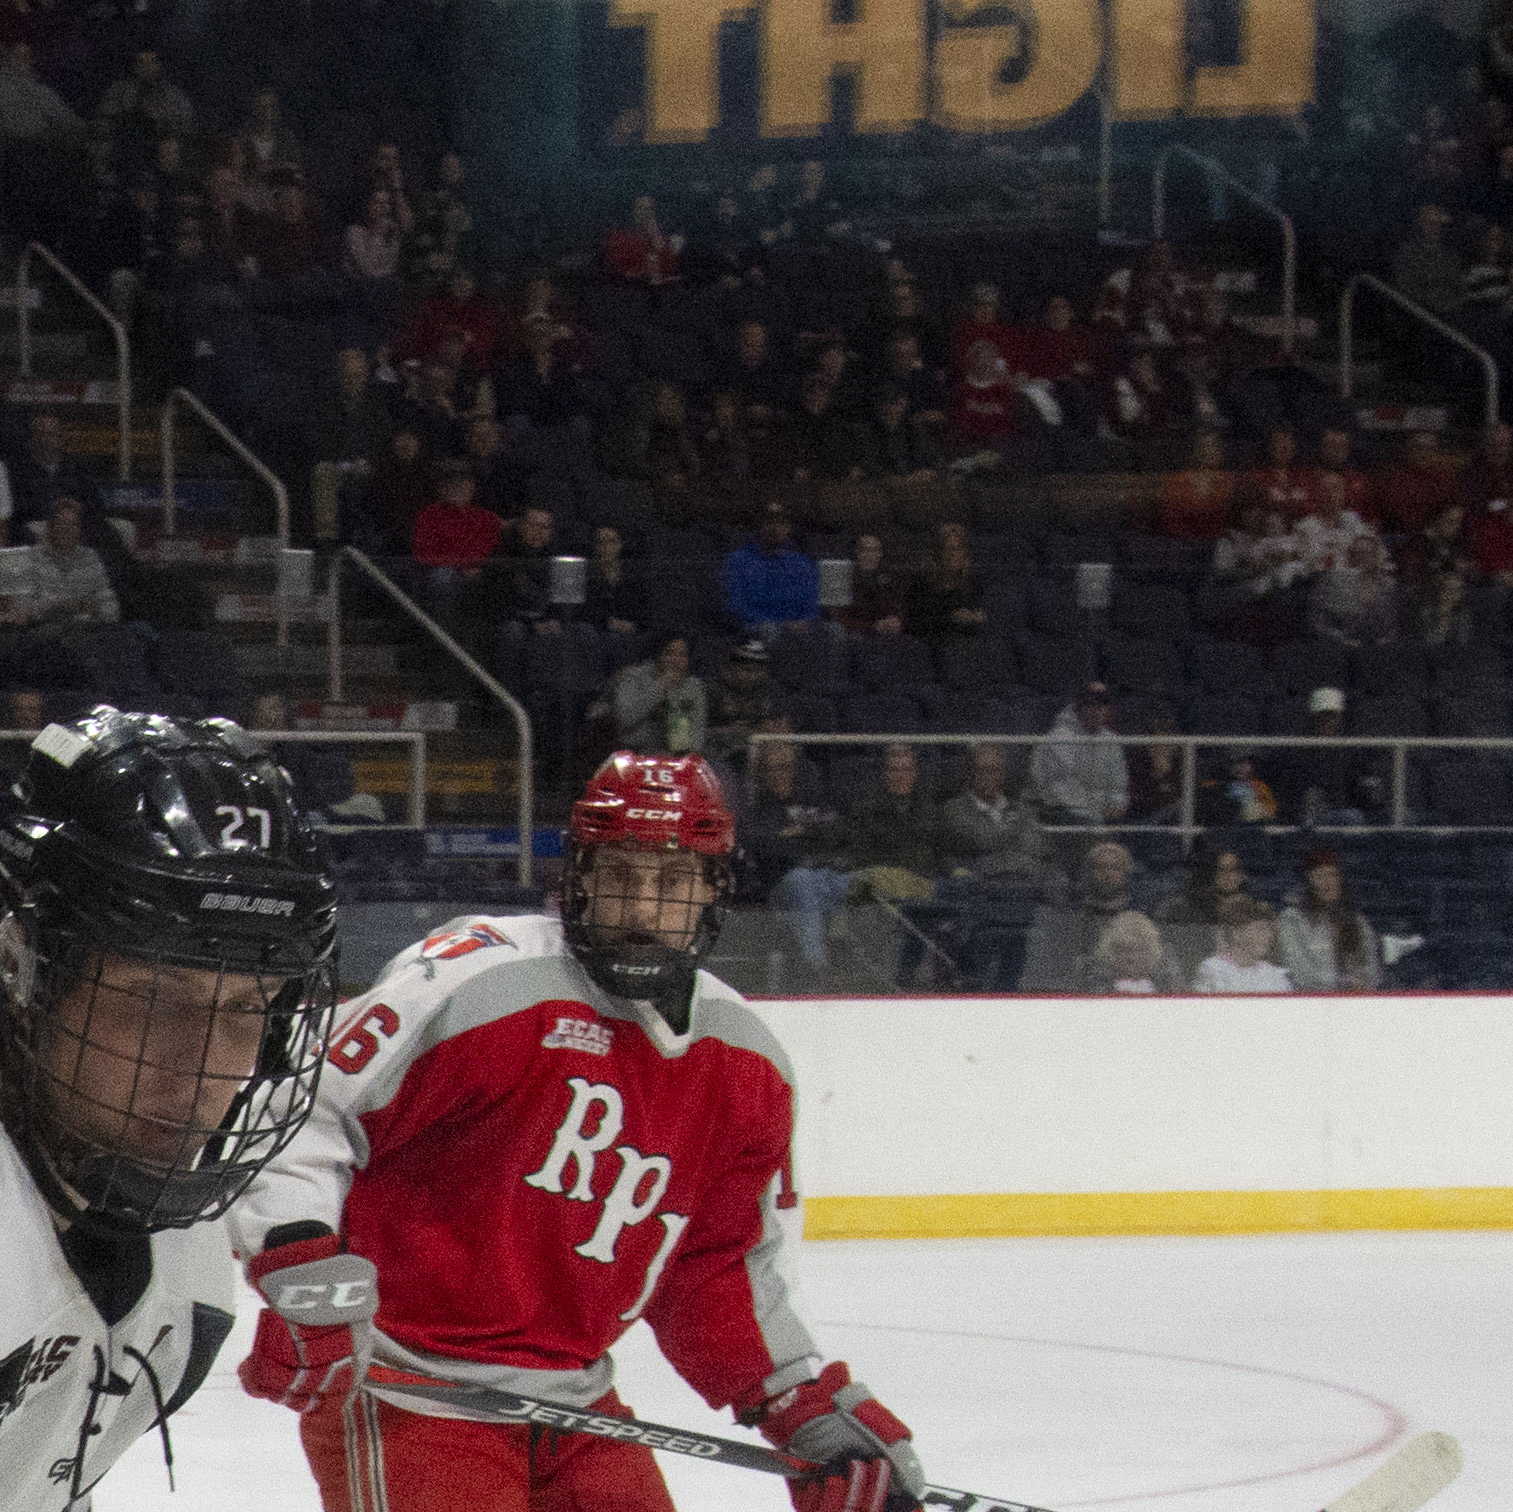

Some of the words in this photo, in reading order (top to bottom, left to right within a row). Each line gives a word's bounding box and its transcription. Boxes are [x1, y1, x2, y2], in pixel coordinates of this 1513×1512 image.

[643, 768, 674, 783] 16
[214, 805, 271, 851] 27
[626, 808, 683, 821] CCM
[200, 892, 294, 917] BAUER
[524, 1077, 691, 1322] RPI
[498, 1399, 722, 1456] JETSPEED
